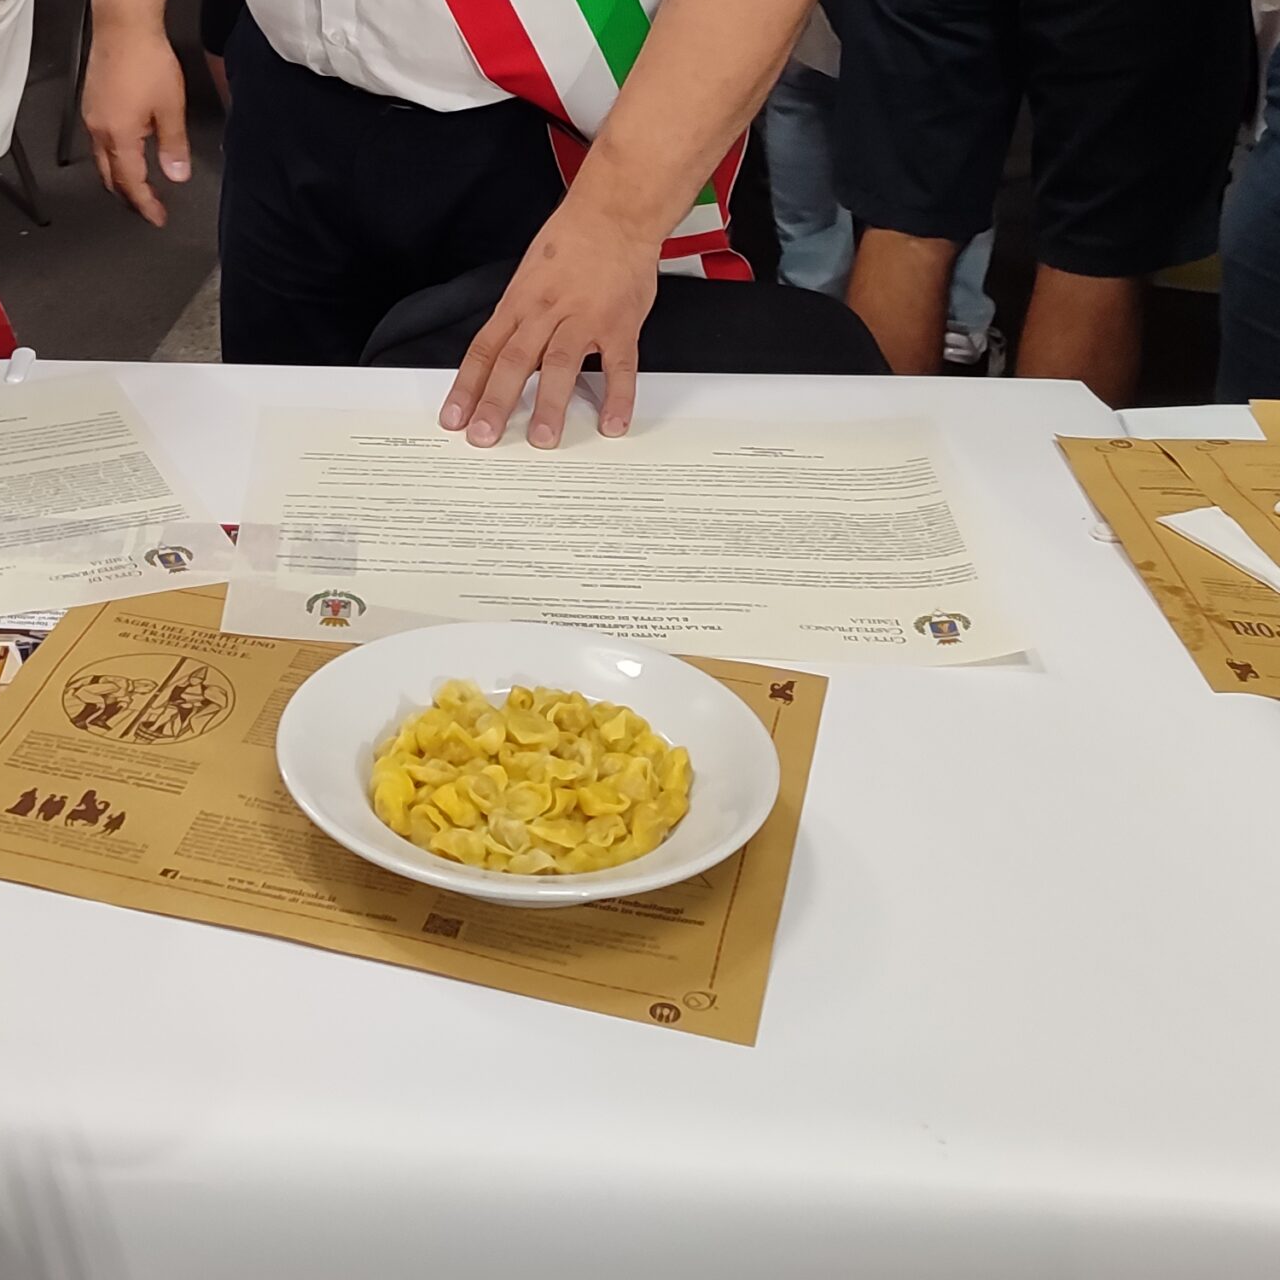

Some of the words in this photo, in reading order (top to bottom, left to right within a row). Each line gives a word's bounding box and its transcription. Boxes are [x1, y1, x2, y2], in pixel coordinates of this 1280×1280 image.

[619, 614, 630, 622] DI
[636, 623, 648, 631] DI
[702, 624, 722, 632] TRA
[114, 616, 160, 631] SAGRA
[160, 623, 187, 634] DEL
[189, 628, 276, 650] TORTELLINO
[617, 631, 629, 639] DI
[632, 631, 668, 639] PATTO
[141, 628, 238, 650] TRADIZIONALE
[131, 633, 237, 659] CASTELFRANCO
